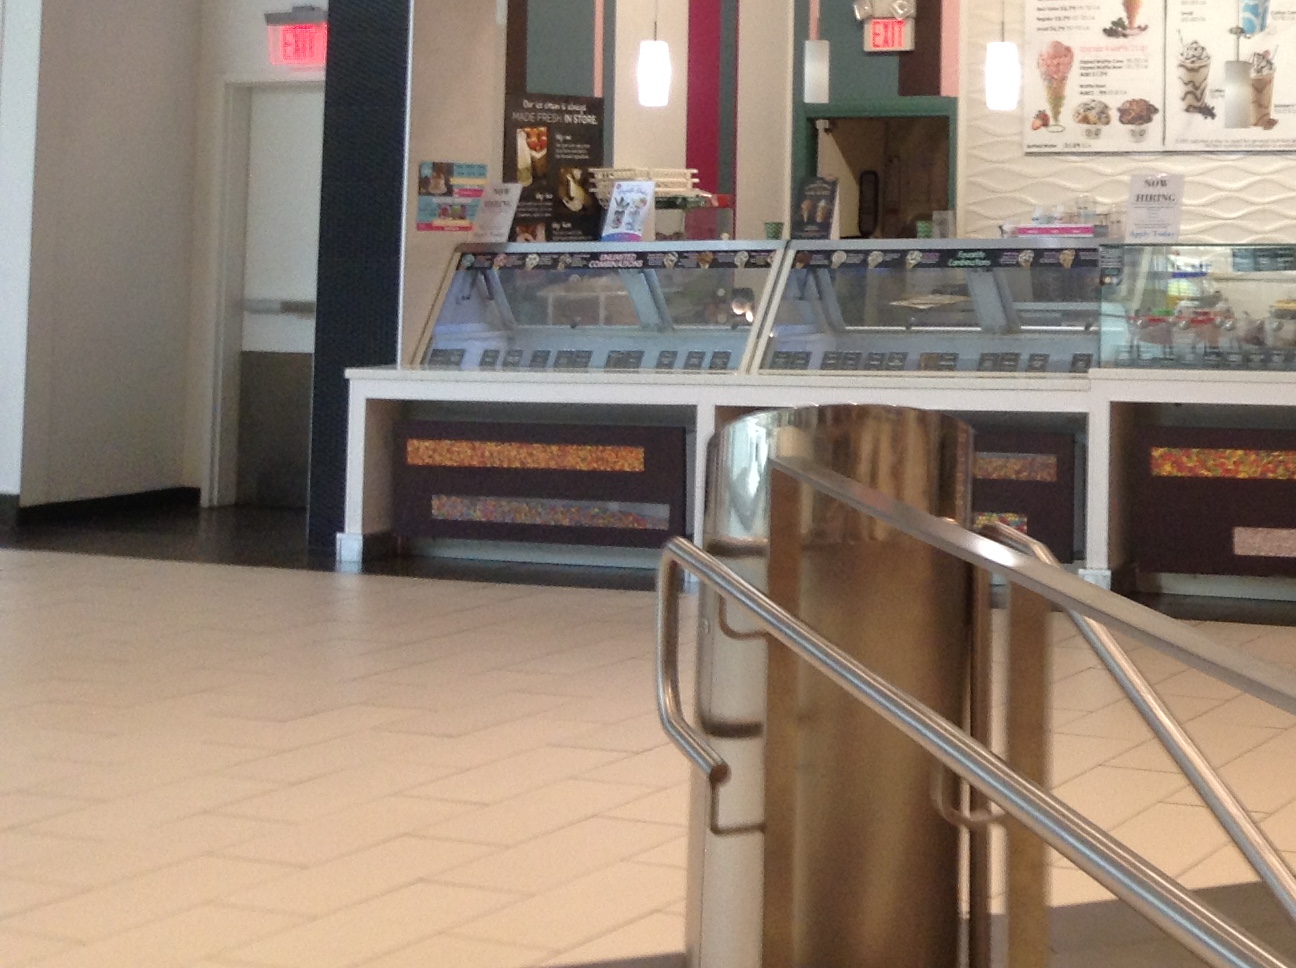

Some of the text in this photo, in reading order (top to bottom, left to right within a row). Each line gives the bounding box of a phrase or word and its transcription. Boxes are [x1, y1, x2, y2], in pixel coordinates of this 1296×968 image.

[871, 18, 905, 49] EXIT
[512, 111, 535, 123] MADE
[564, 113, 573, 124] IN
[1144, 178, 1168, 188] NOW
[1135, 193, 1176, 203] HIRING
